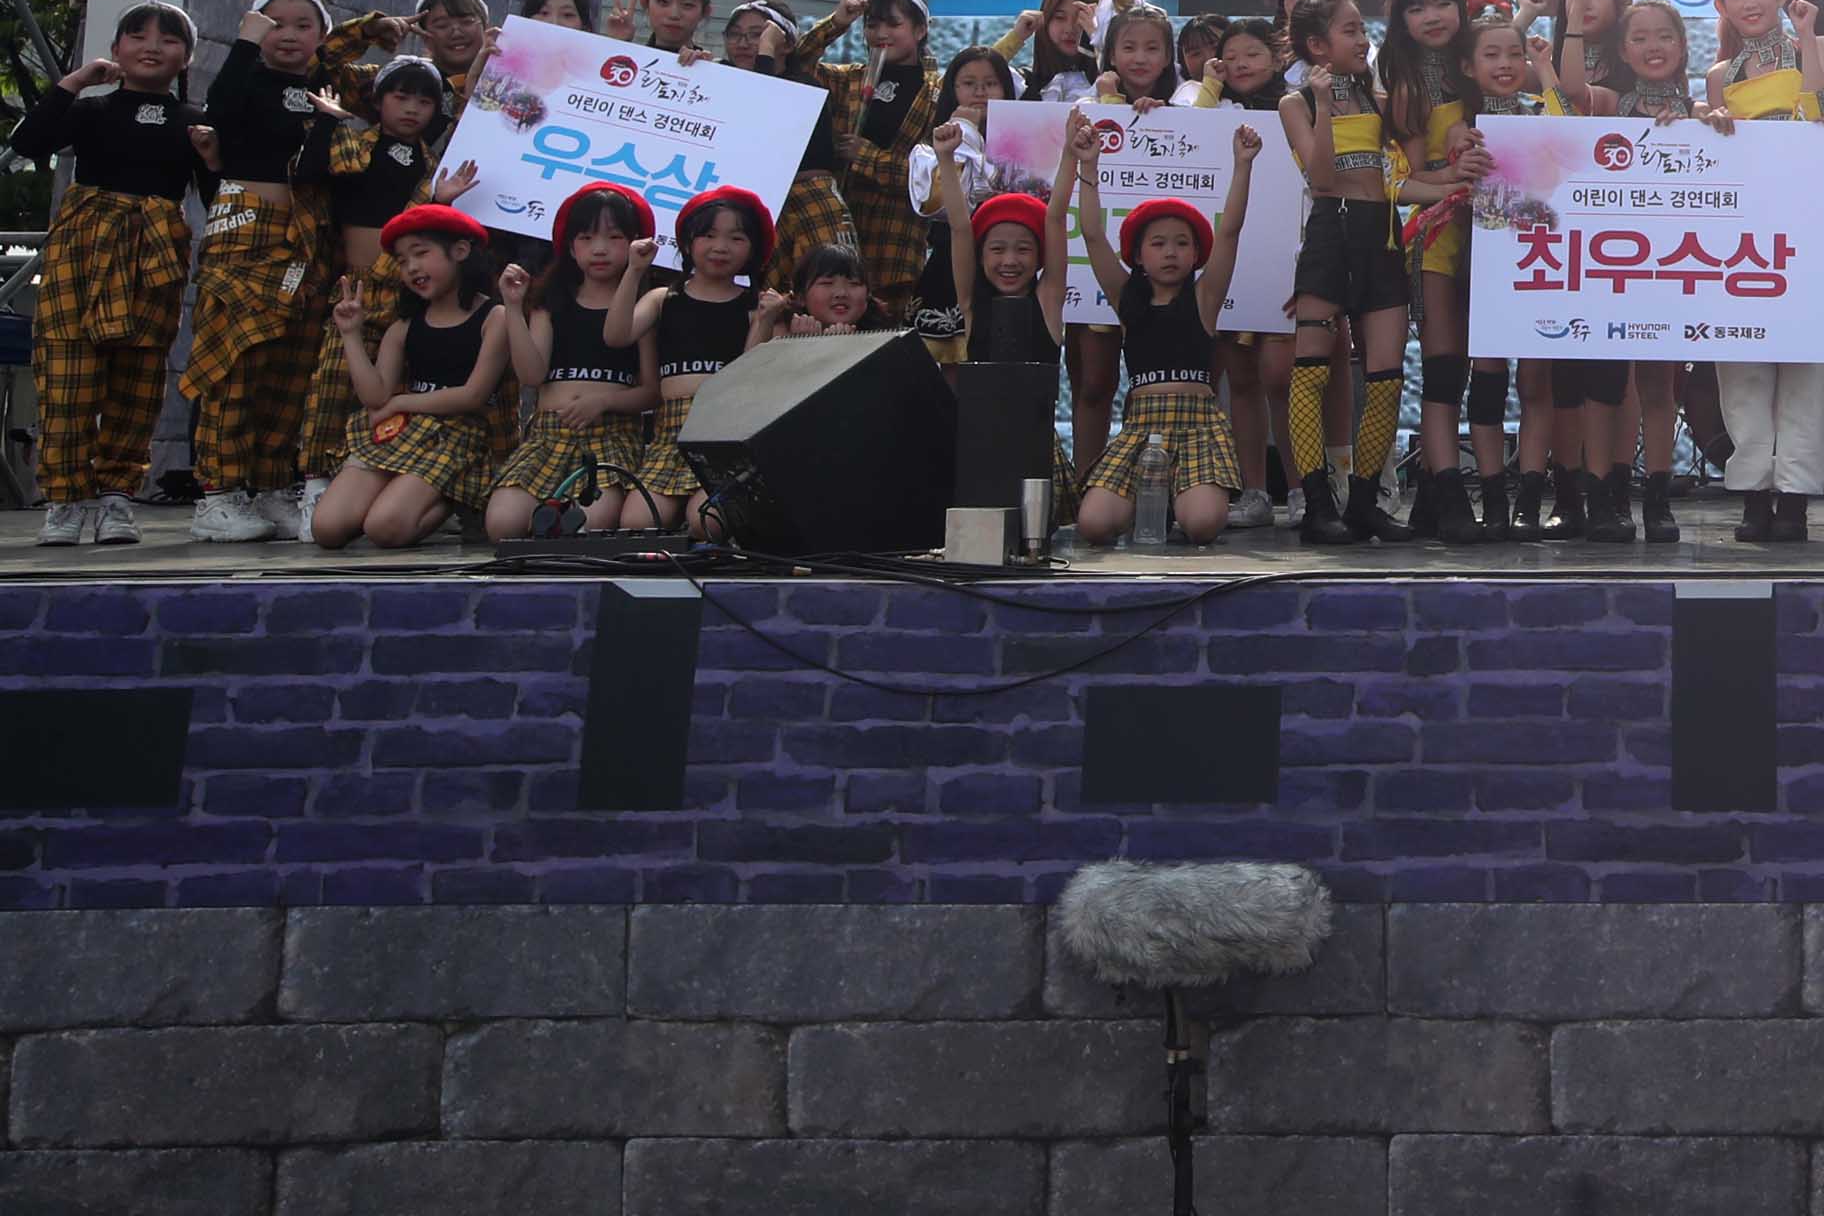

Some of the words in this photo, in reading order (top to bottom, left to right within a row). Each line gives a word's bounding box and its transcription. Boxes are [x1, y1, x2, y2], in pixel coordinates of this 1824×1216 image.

[567, 92, 615, 118] 어린이
[619, 104, 648, 124] 댄스
[653, 113, 717, 141] 경연대회
[1120, 170, 1150, 187] 댄스
[1155, 171, 1216, 192] 경연대회
[1572, 188, 1624, 208] 어린이
[1630, 189, 1664, 208] 댄스
[1670, 189, 1738, 209] 경연대회
[1513, 225, 1796, 298] 최우수상
[1627, 323, 1671, 331] HYUNDAI
[1627, 331, 1659, 340] STEEL
[1713, 325, 1766, 340] 동국제강
[1171, 369, 1204, 382] LOVE
